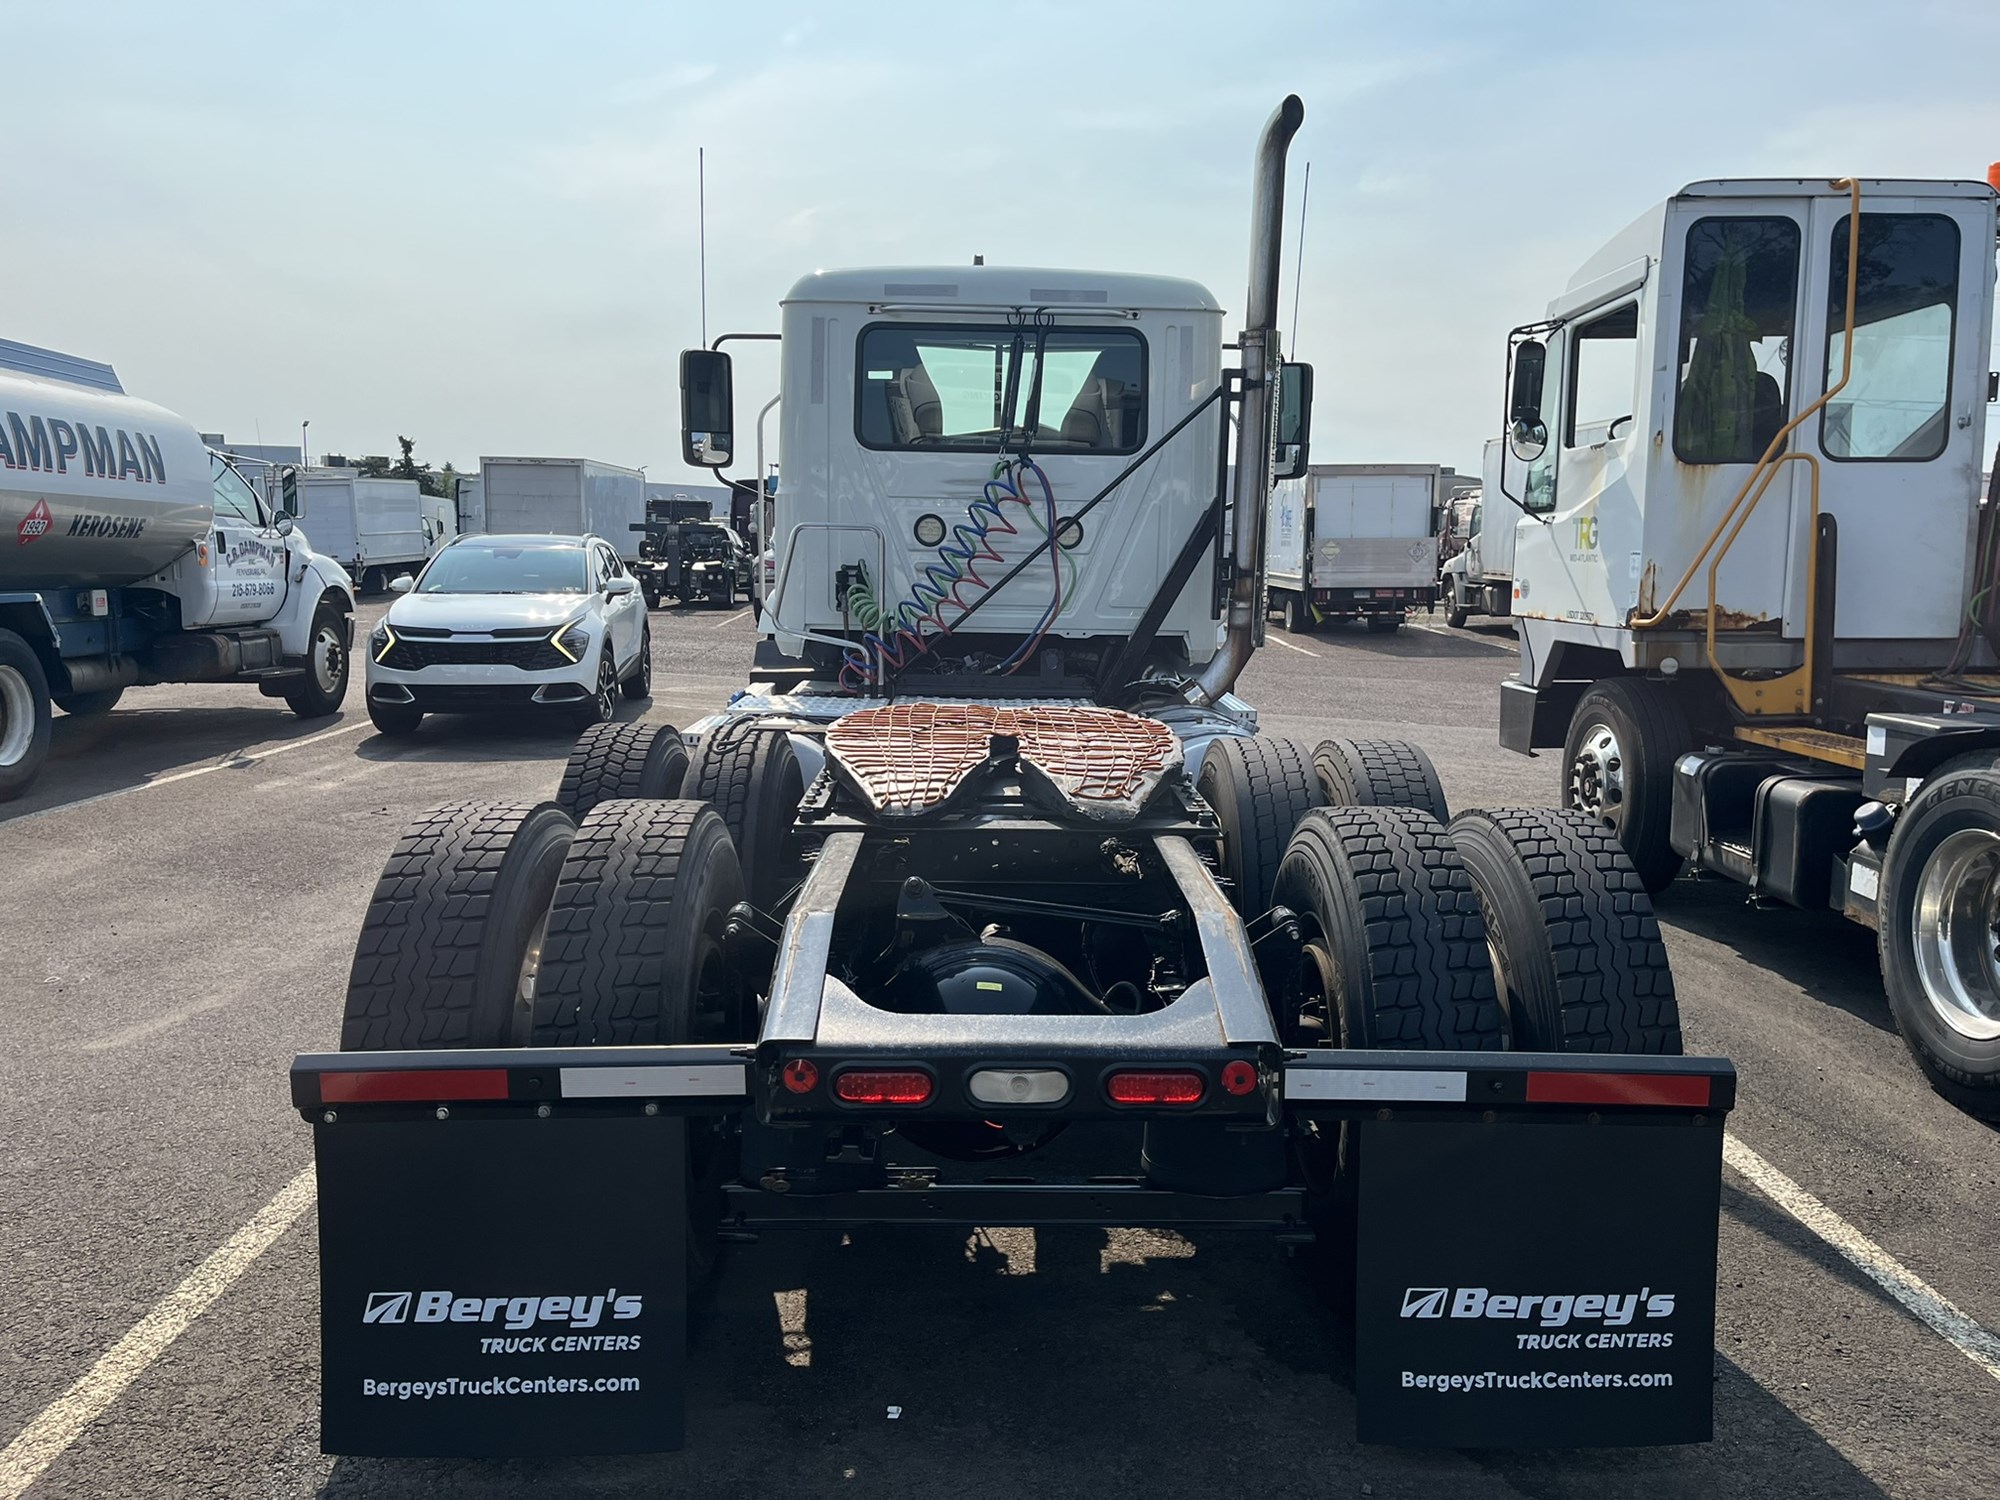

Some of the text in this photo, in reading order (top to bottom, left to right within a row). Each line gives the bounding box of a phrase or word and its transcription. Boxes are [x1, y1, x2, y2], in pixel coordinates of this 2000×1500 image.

[22, 520, 47, 535] 1993
[66, 514, 147, 539] KEROSENE
[1572, 516, 1599, 550] TRG
[239, 540, 276, 568] DAMPMAN
[414, 1288, 642, 1330] Bergey's
[1450, 1287, 1675, 1327] Bergey's
[480, 1335, 641, 1354] TRUCK CENTERS
[1516, 1332, 1674, 1350] TRUCK CENTERS
[363, 1376, 640, 1400] BergeysTruckCenters.com
[1401, 1371, 1673, 1393] BergeysTruckCenters.com
